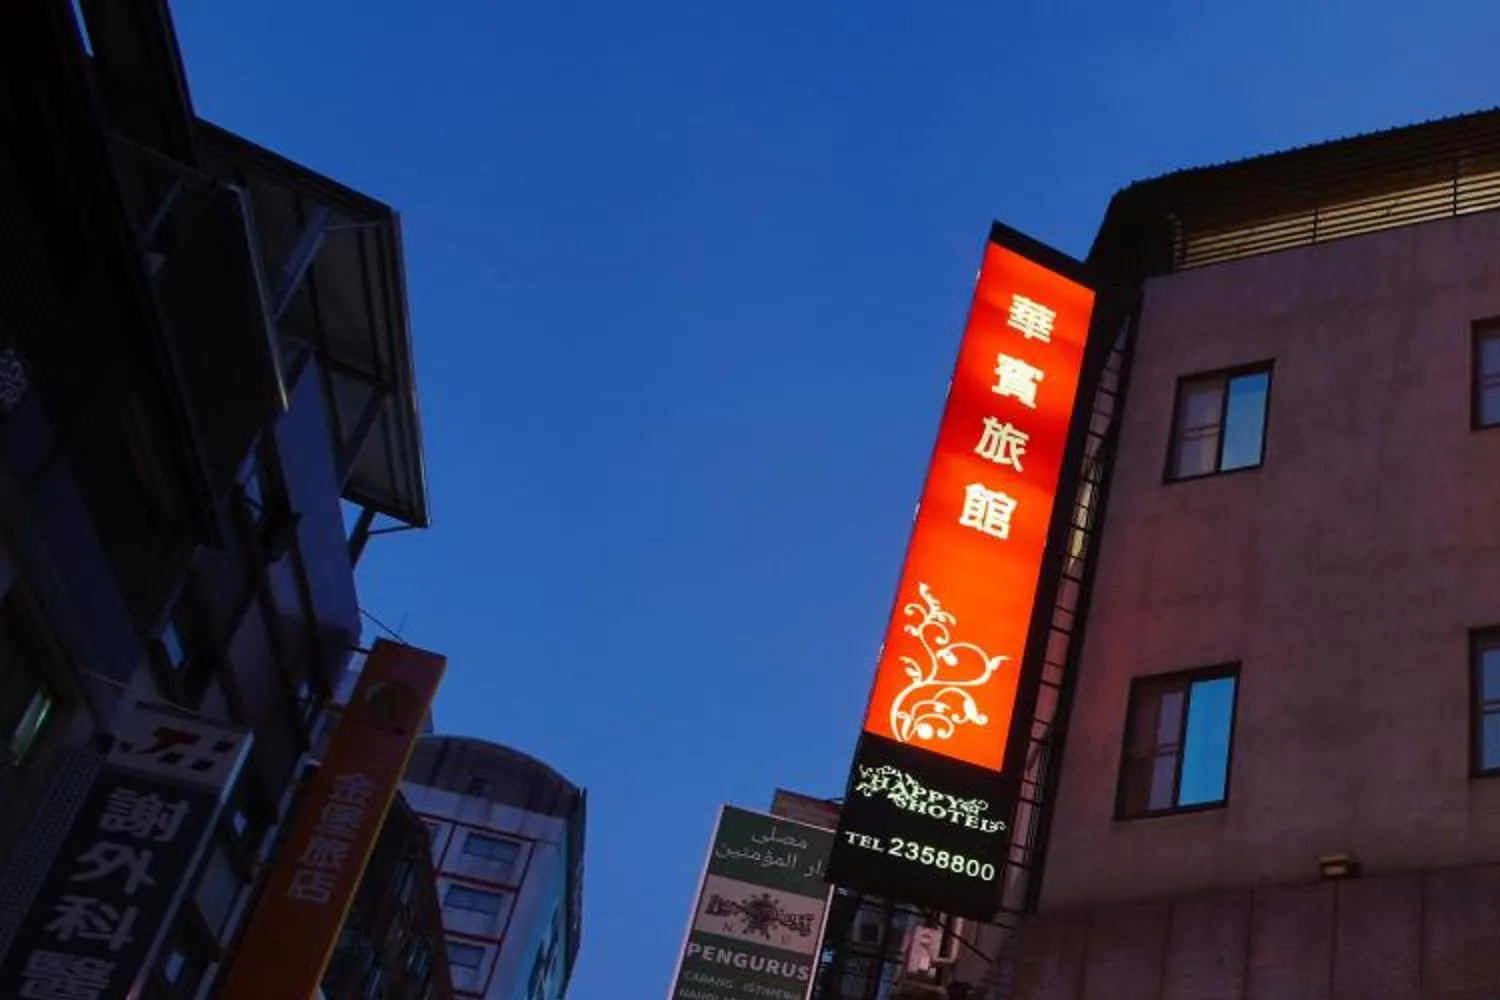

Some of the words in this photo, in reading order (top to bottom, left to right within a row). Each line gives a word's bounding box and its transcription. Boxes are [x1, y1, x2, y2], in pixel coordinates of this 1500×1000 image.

[959, 293, 1057, 540] 華賓旅館
[868, 769, 966, 813] HAPPY
[906, 798, 1000, 833] HOTEL
[845, 831, 885, 851] TEL
[888, 837, 995, 881] 2358800
[686, 942, 812, 982] PENGURUS
